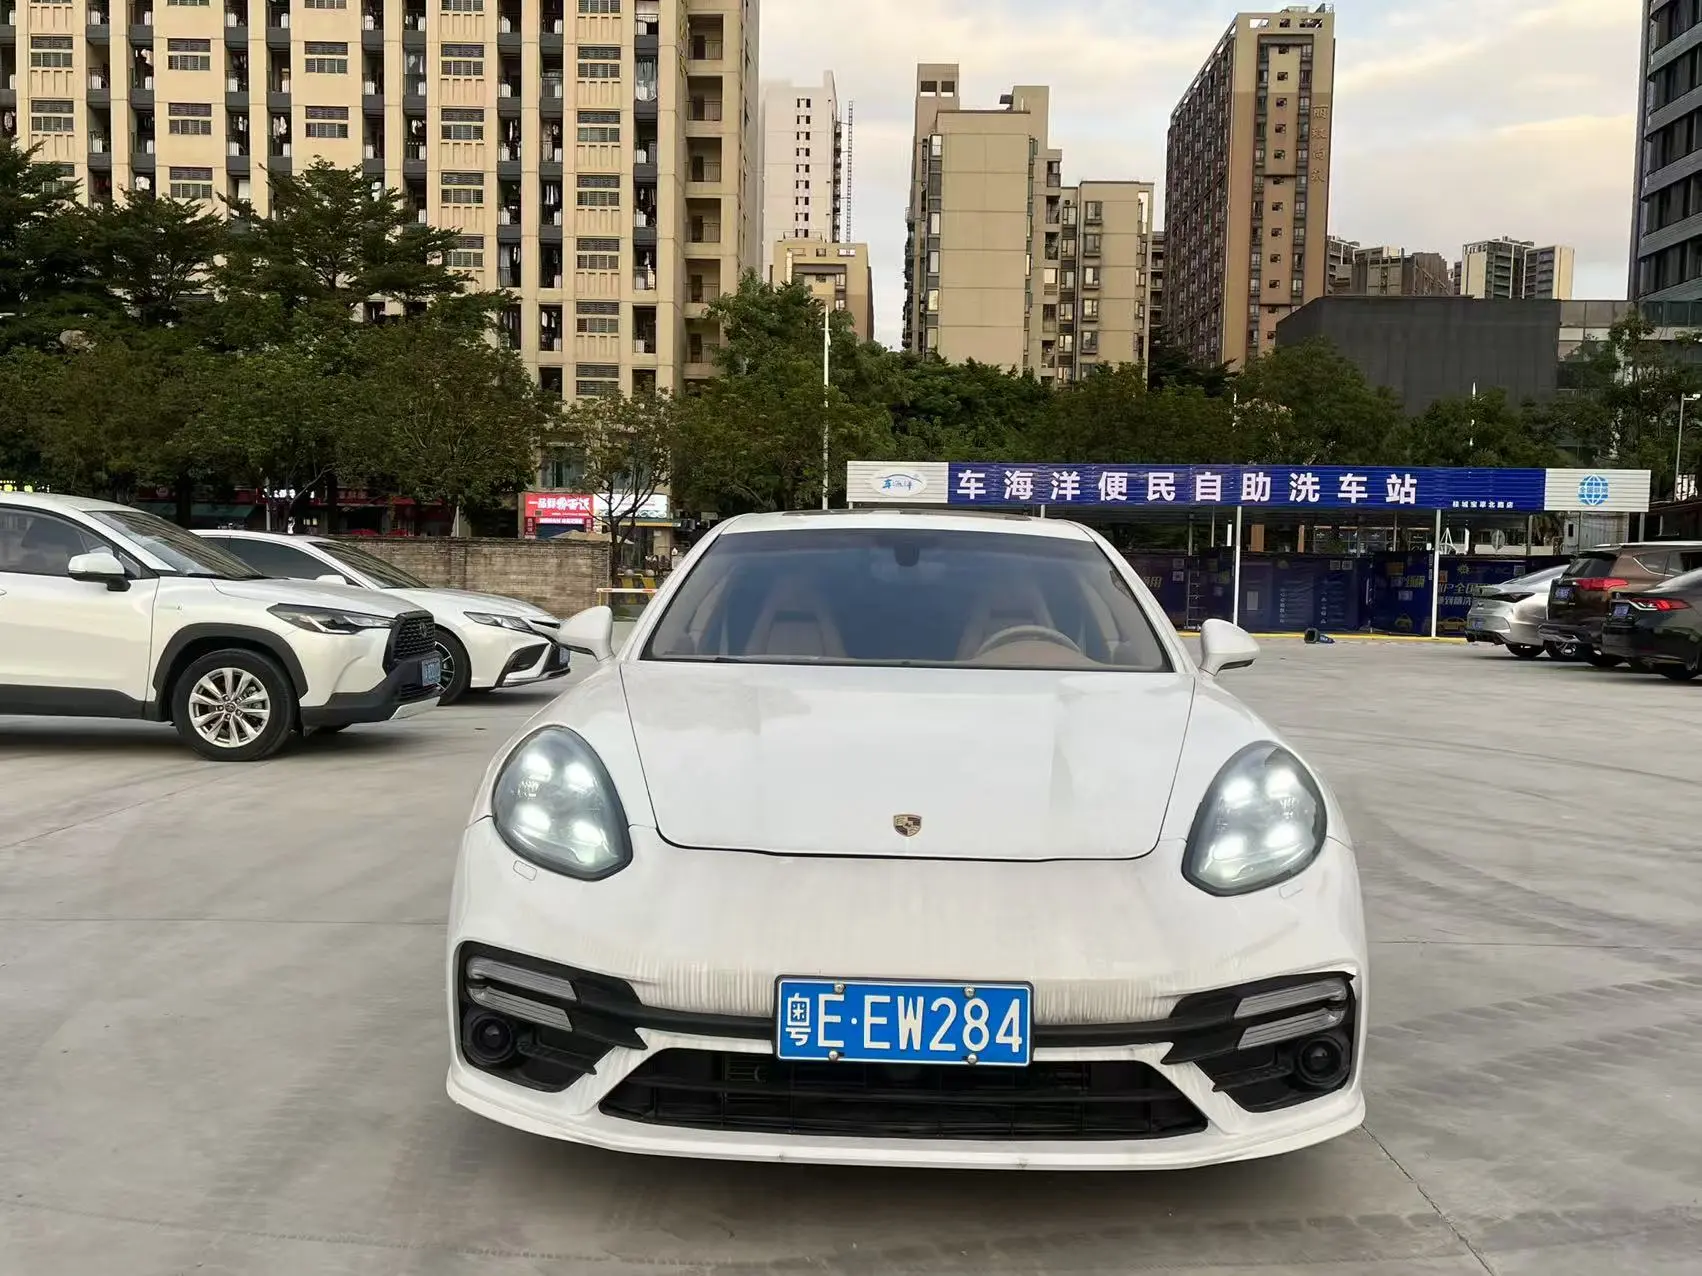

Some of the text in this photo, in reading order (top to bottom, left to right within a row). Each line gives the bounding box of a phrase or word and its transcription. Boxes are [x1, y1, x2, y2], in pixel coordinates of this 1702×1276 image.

[956, 469, 1418, 505] 车海洋便民自助洗车站
[785, 992, 1023, 1054] 粤E·EW284
